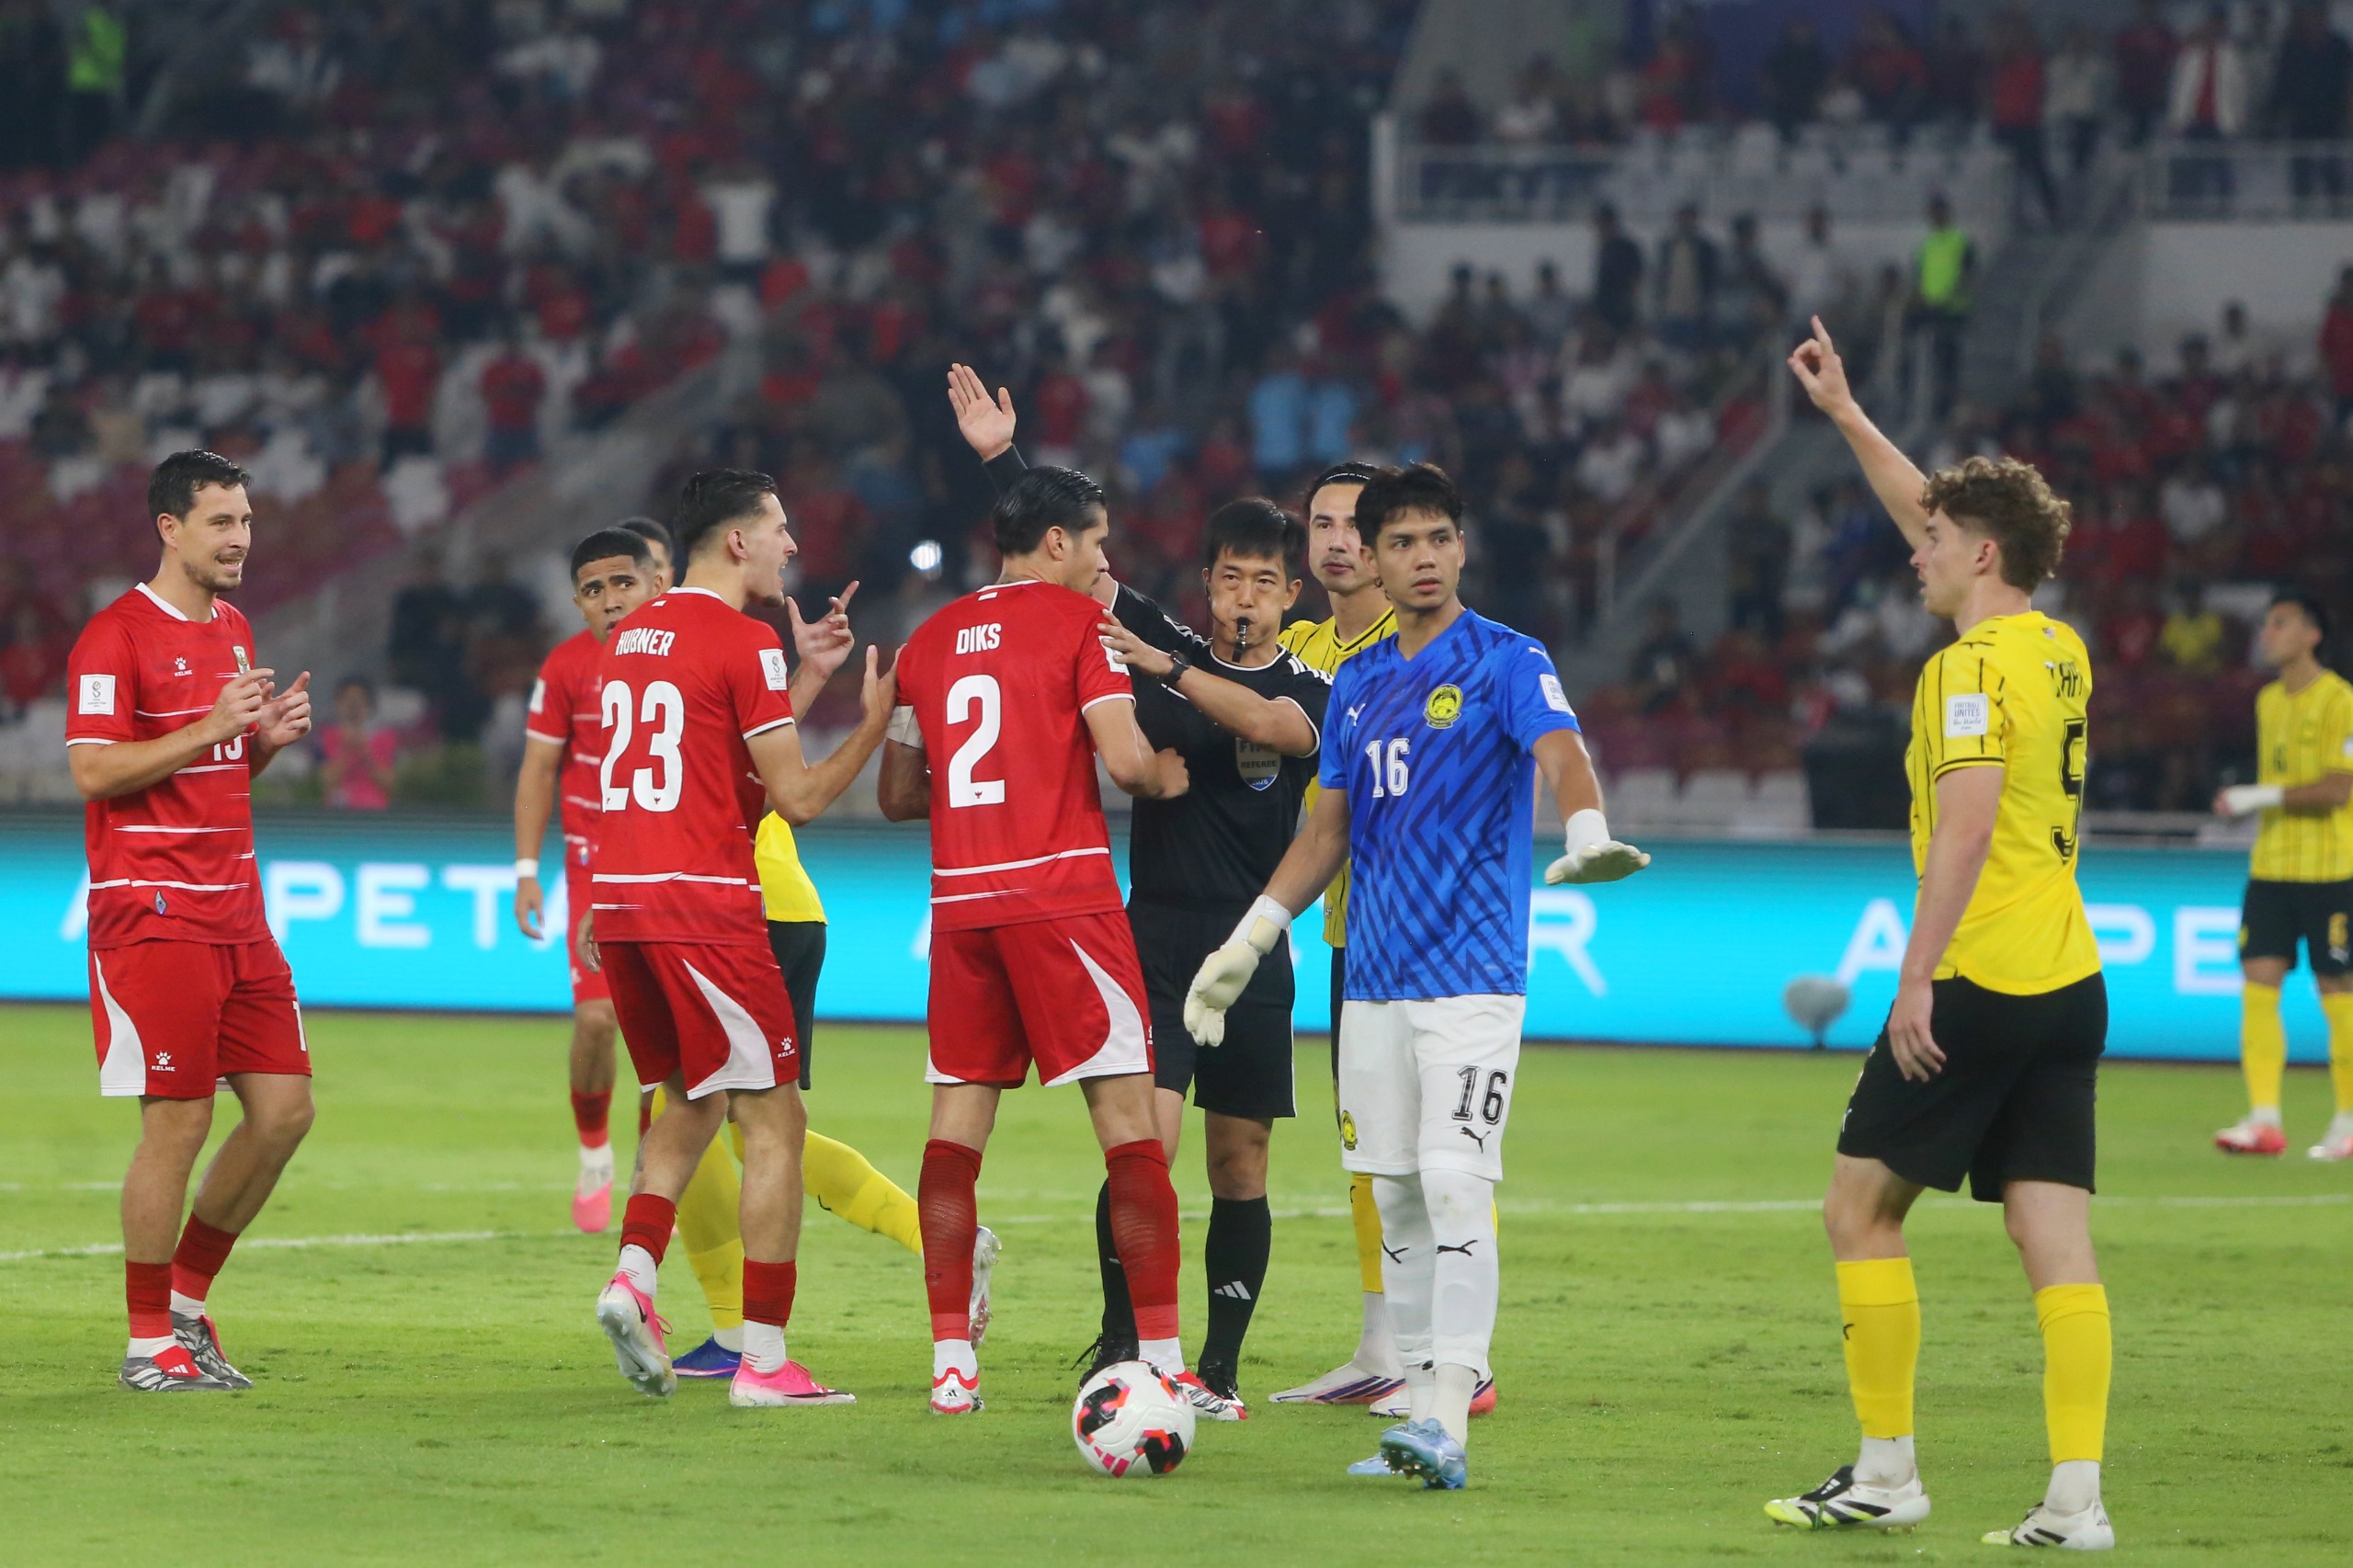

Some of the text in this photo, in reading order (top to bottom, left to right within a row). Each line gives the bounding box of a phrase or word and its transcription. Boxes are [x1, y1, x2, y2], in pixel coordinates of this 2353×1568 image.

[615, 627, 676, 656] HUBNER
[955, 622, 1002, 654] DIKS
[946, 674, 1006, 809] 2
[1954, 709, 1981, 717] UNITES
[600, 679, 685, 812] 23
[1241, 760, 1277, 768] REFEREE
[1365, 738, 1410, 798] 16
[2051, 717, 2086, 865] 5
[1451, 1064, 1508, 1126] 16
